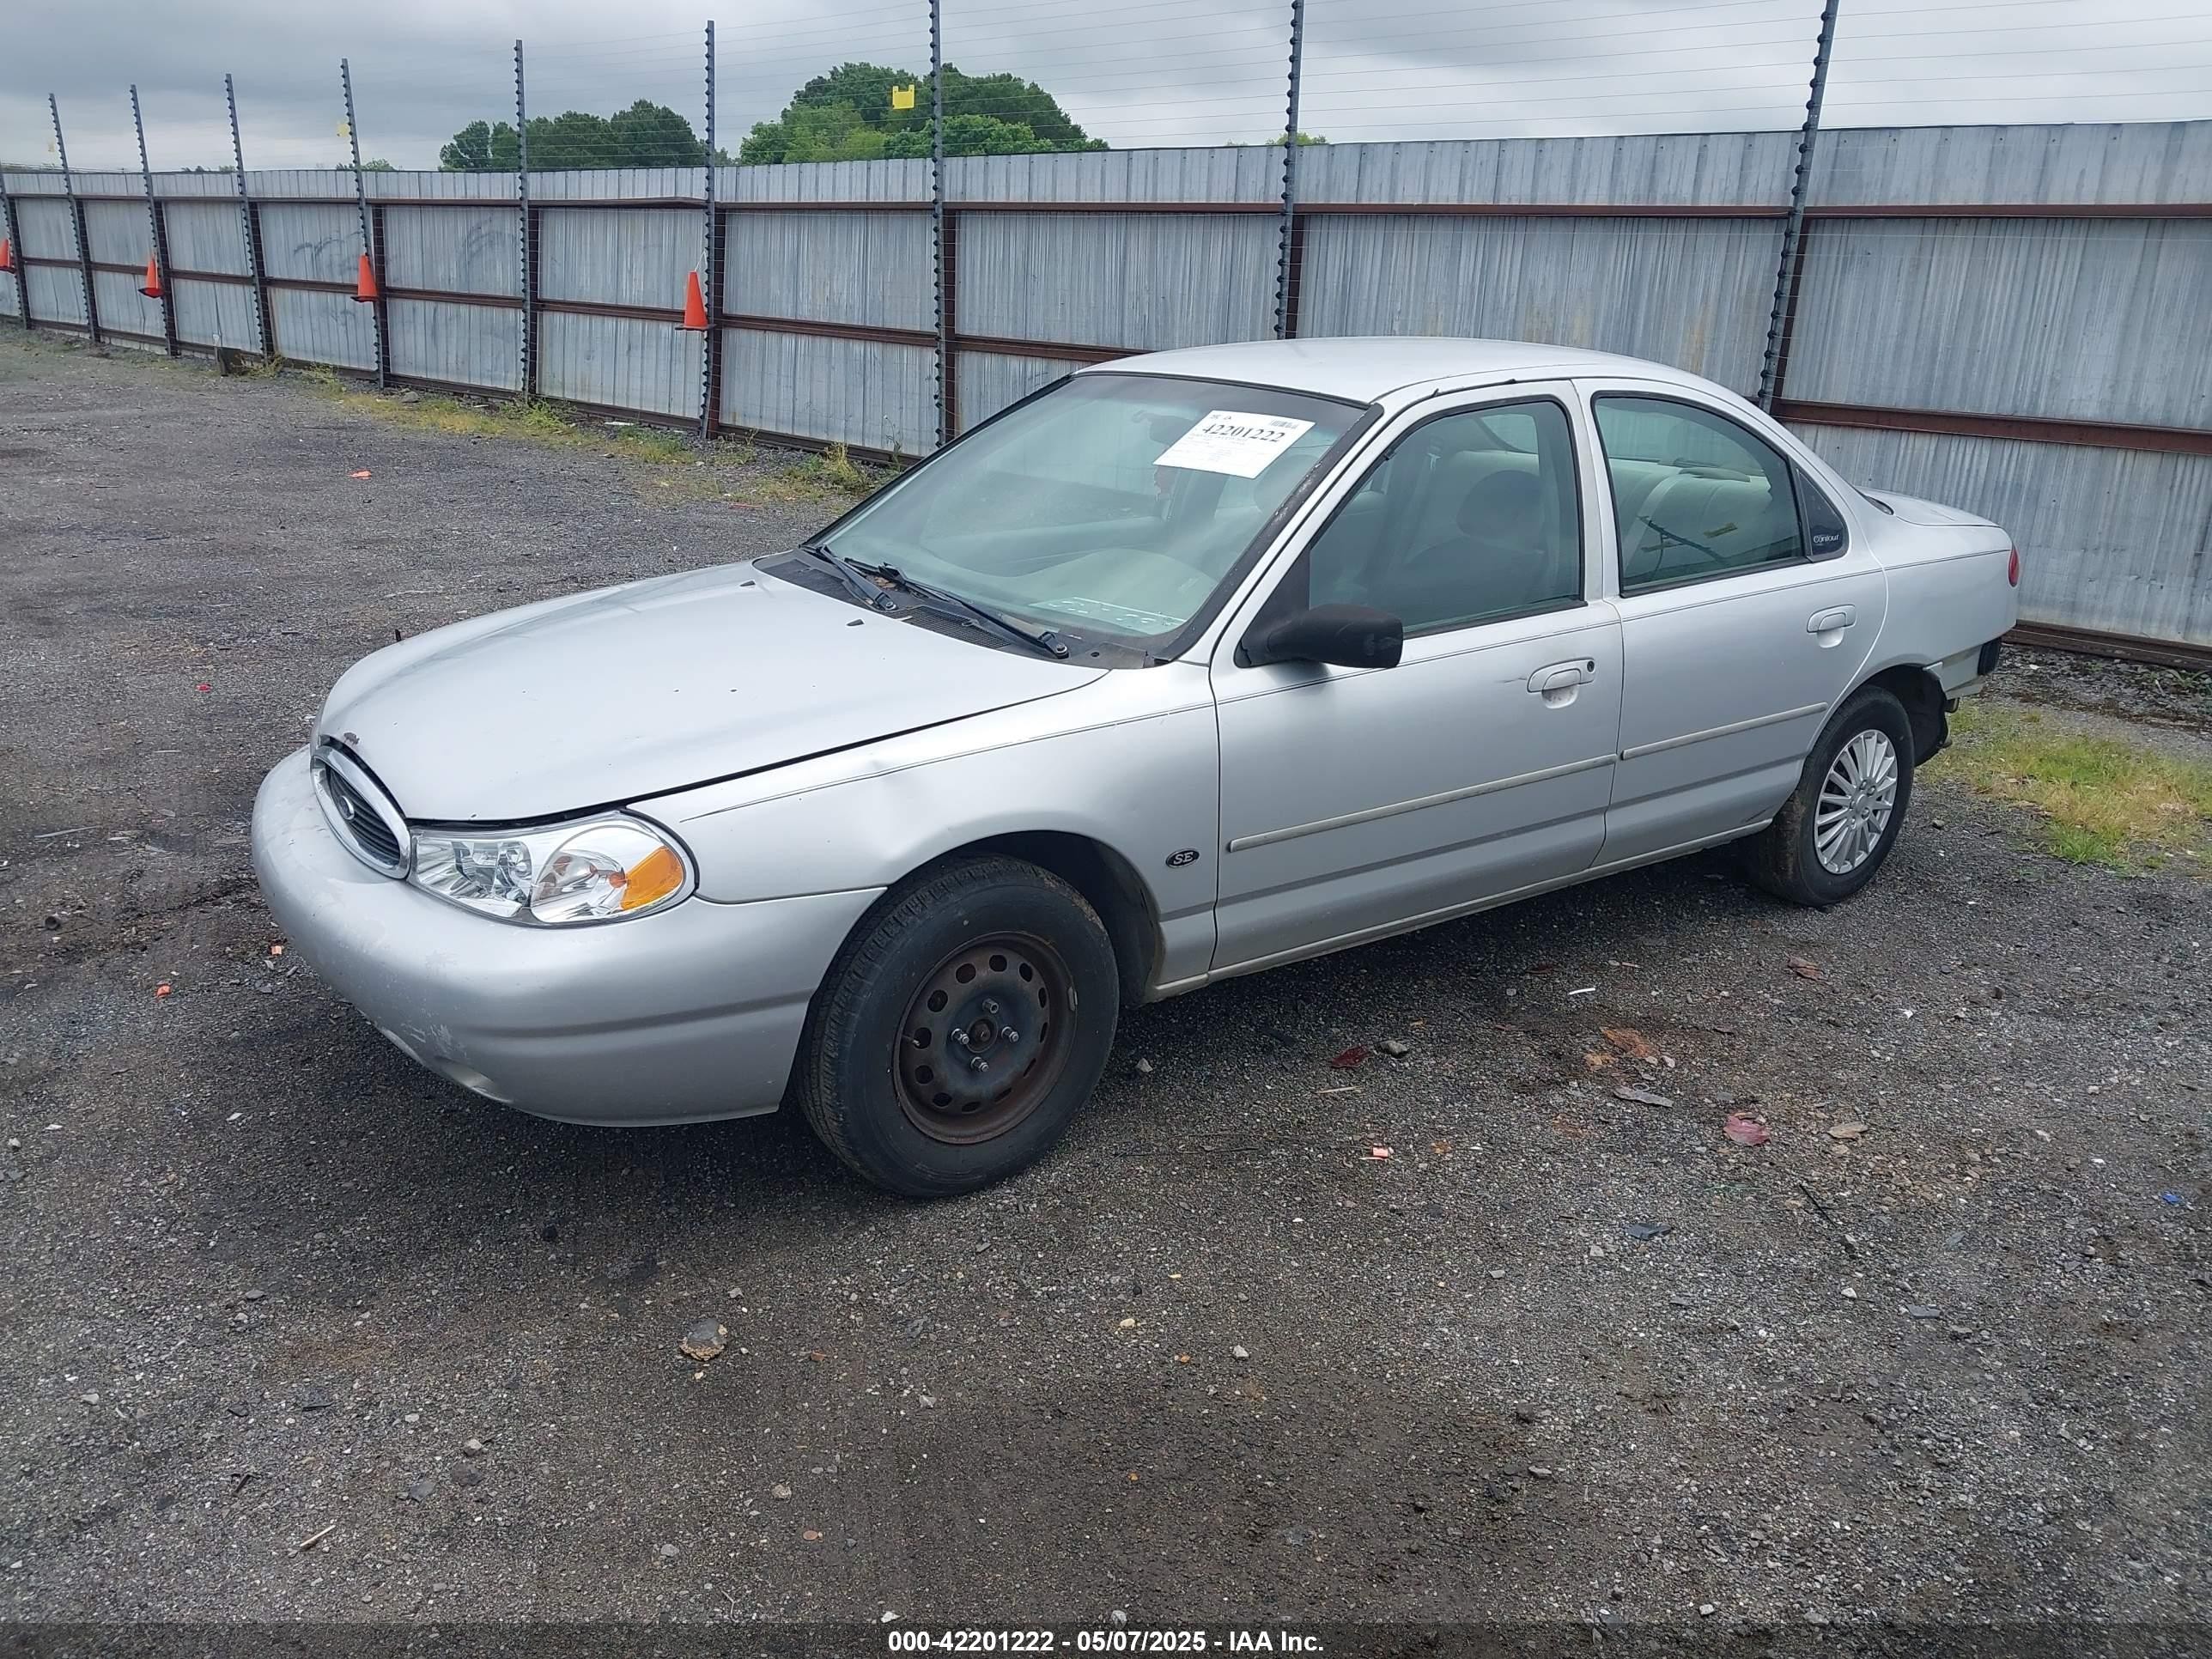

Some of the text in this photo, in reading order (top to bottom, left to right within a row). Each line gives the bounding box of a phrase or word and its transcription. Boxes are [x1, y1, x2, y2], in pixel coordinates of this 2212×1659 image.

[1202, 423, 1285, 442] 42201222
[1813, 534, 1839, 544] Contour
[1173, 851, 1194, 865] SE
